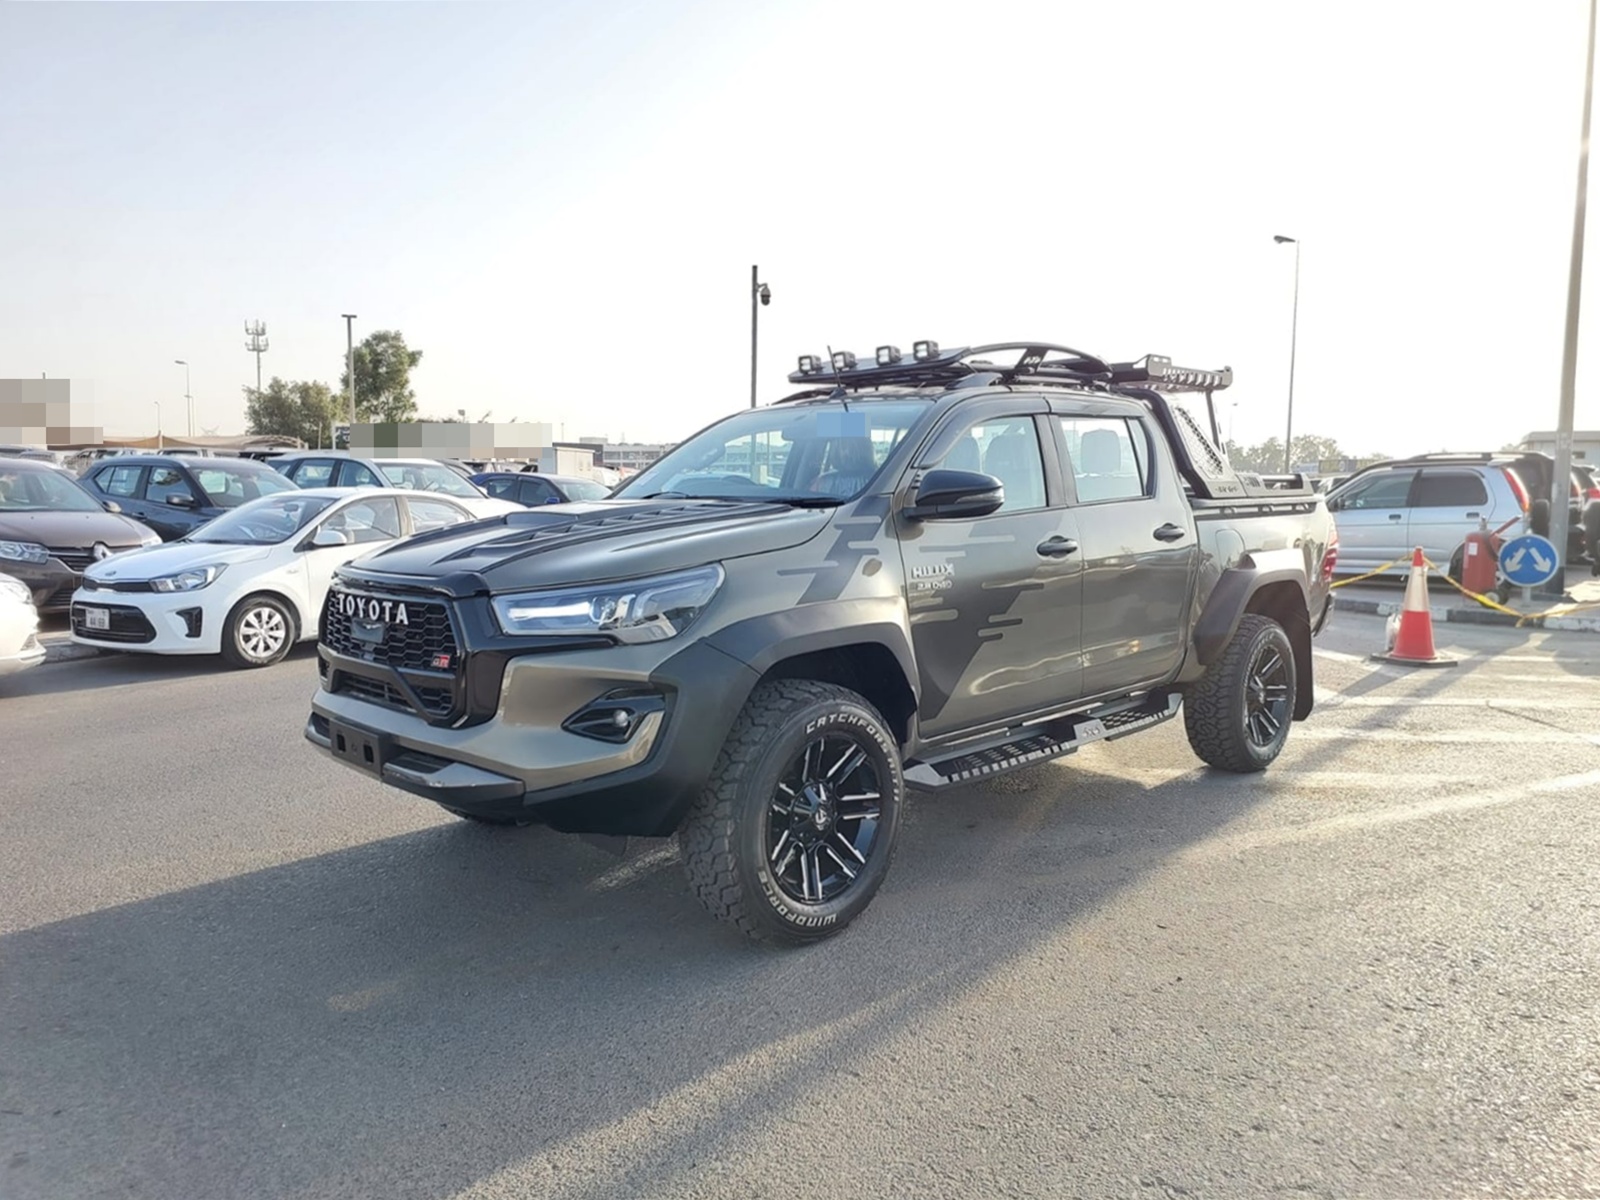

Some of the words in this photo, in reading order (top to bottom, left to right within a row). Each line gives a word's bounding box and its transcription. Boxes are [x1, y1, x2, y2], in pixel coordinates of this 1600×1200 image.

[911, 563, 955, 579] HILUX
[337, 593, 409, 625] TOYOTA
[806, 713, 889, 753] CATCHFORS
[758, 870, 837, 927] WINDFORCE
